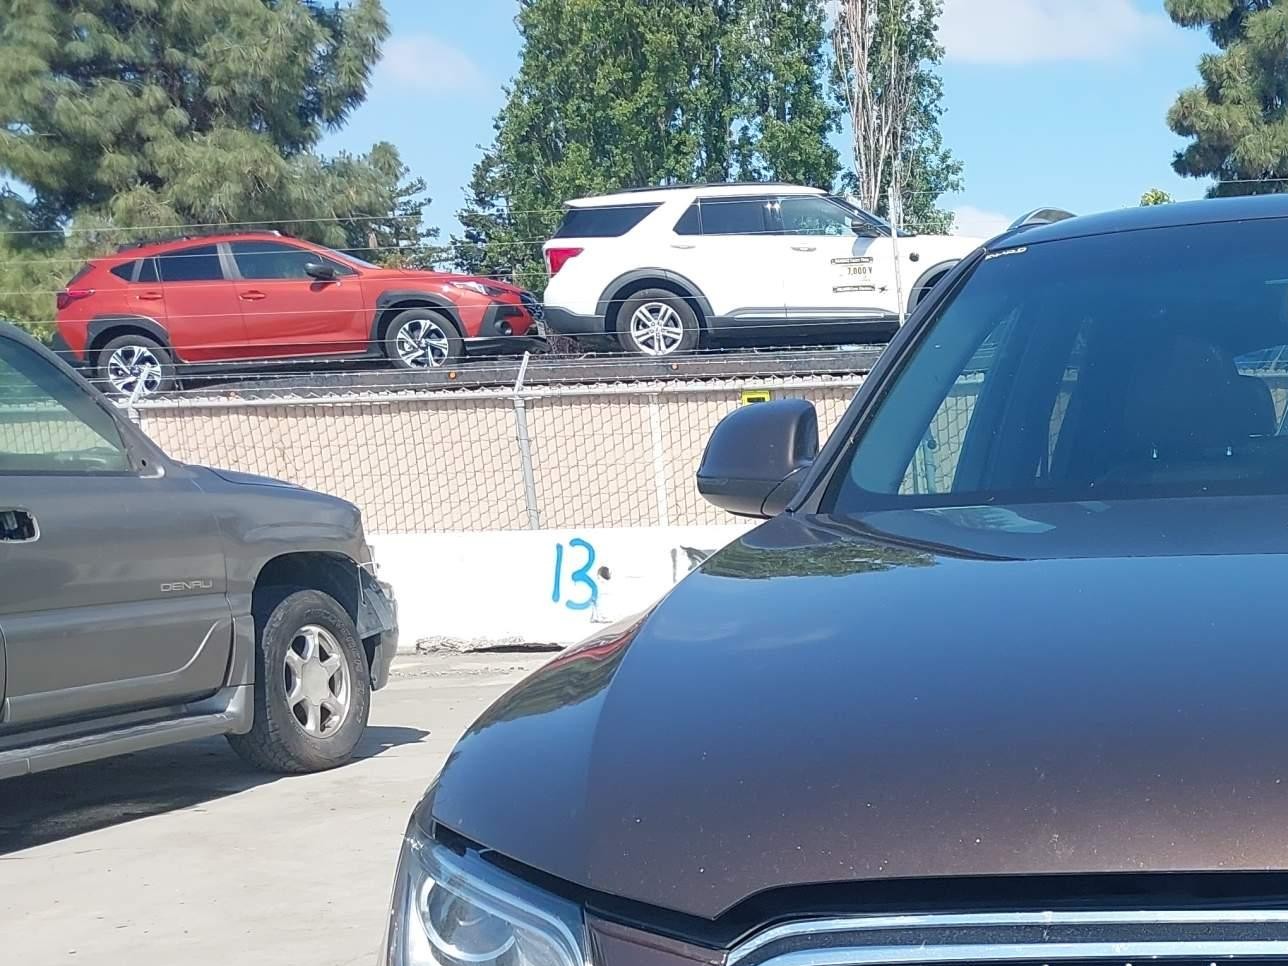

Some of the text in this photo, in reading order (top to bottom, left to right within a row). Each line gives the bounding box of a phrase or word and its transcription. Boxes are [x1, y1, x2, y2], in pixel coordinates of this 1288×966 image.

[847, 266, 873, 276] 7,000 V
[552, 538, 598, 610] 13
[160, 579, 213, 592] DENALI
